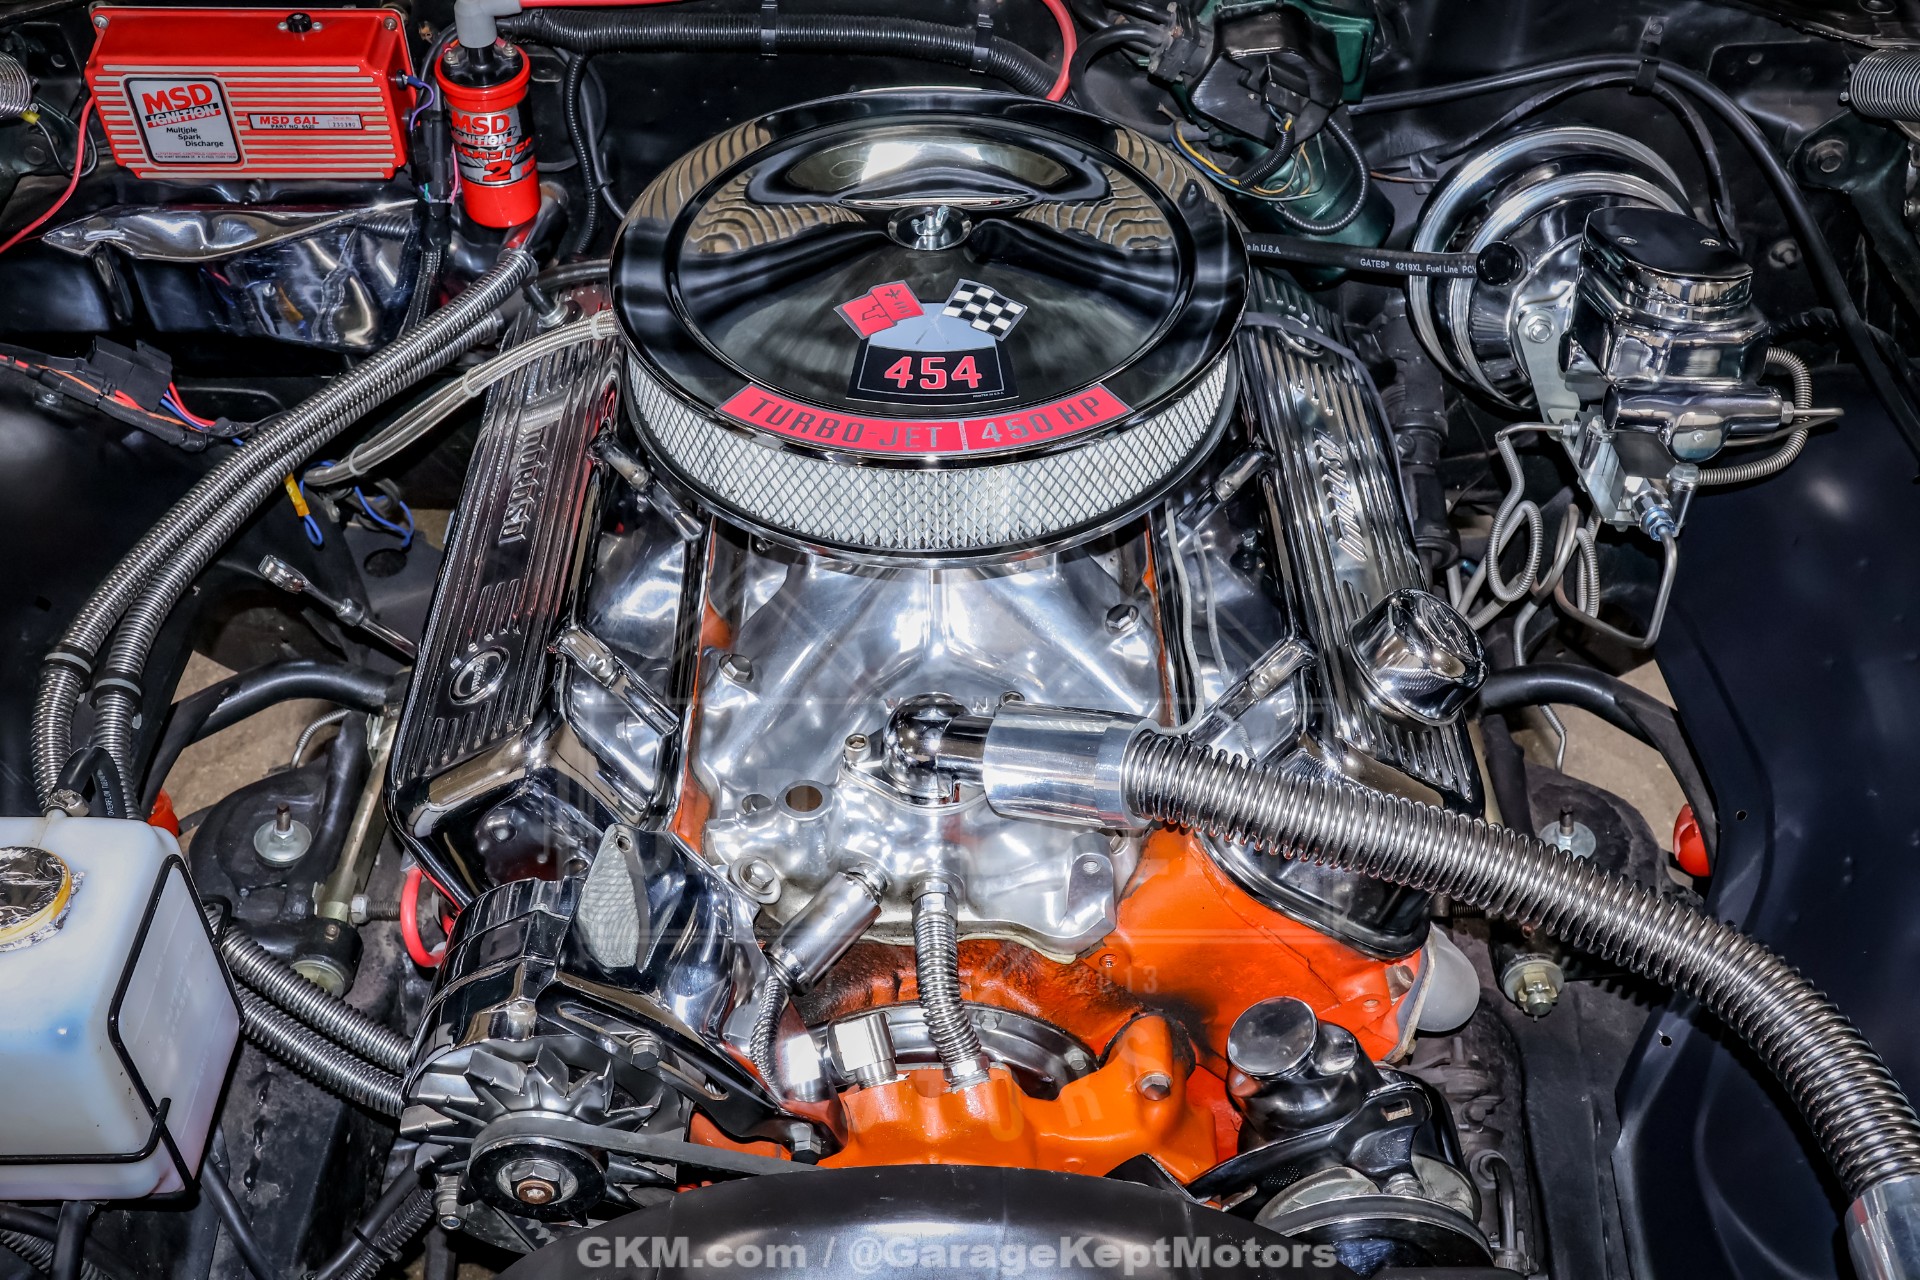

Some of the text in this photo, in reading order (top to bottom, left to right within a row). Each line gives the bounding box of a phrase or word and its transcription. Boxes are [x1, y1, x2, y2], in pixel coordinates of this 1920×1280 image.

[142, 83, 213, 114] MSD
[149, 104, 217, 127] IGNITION
[260, 116, 320, 125] MSD 6AL
[451, 110, 511, 135] MSD
[482, 160, 513, 181] 2
[1395, 262, 1422, 272] 4219XL
[1426, 264, 1442, 273] Fuel
[1443, 265, 1458, 273] Line
[883, 355, 982, 390] 454
[748, 397, 943, 448] TURBO-JET
[979, 412, 1052, 443] 450
[1064, 396, 1101, 426] HP
